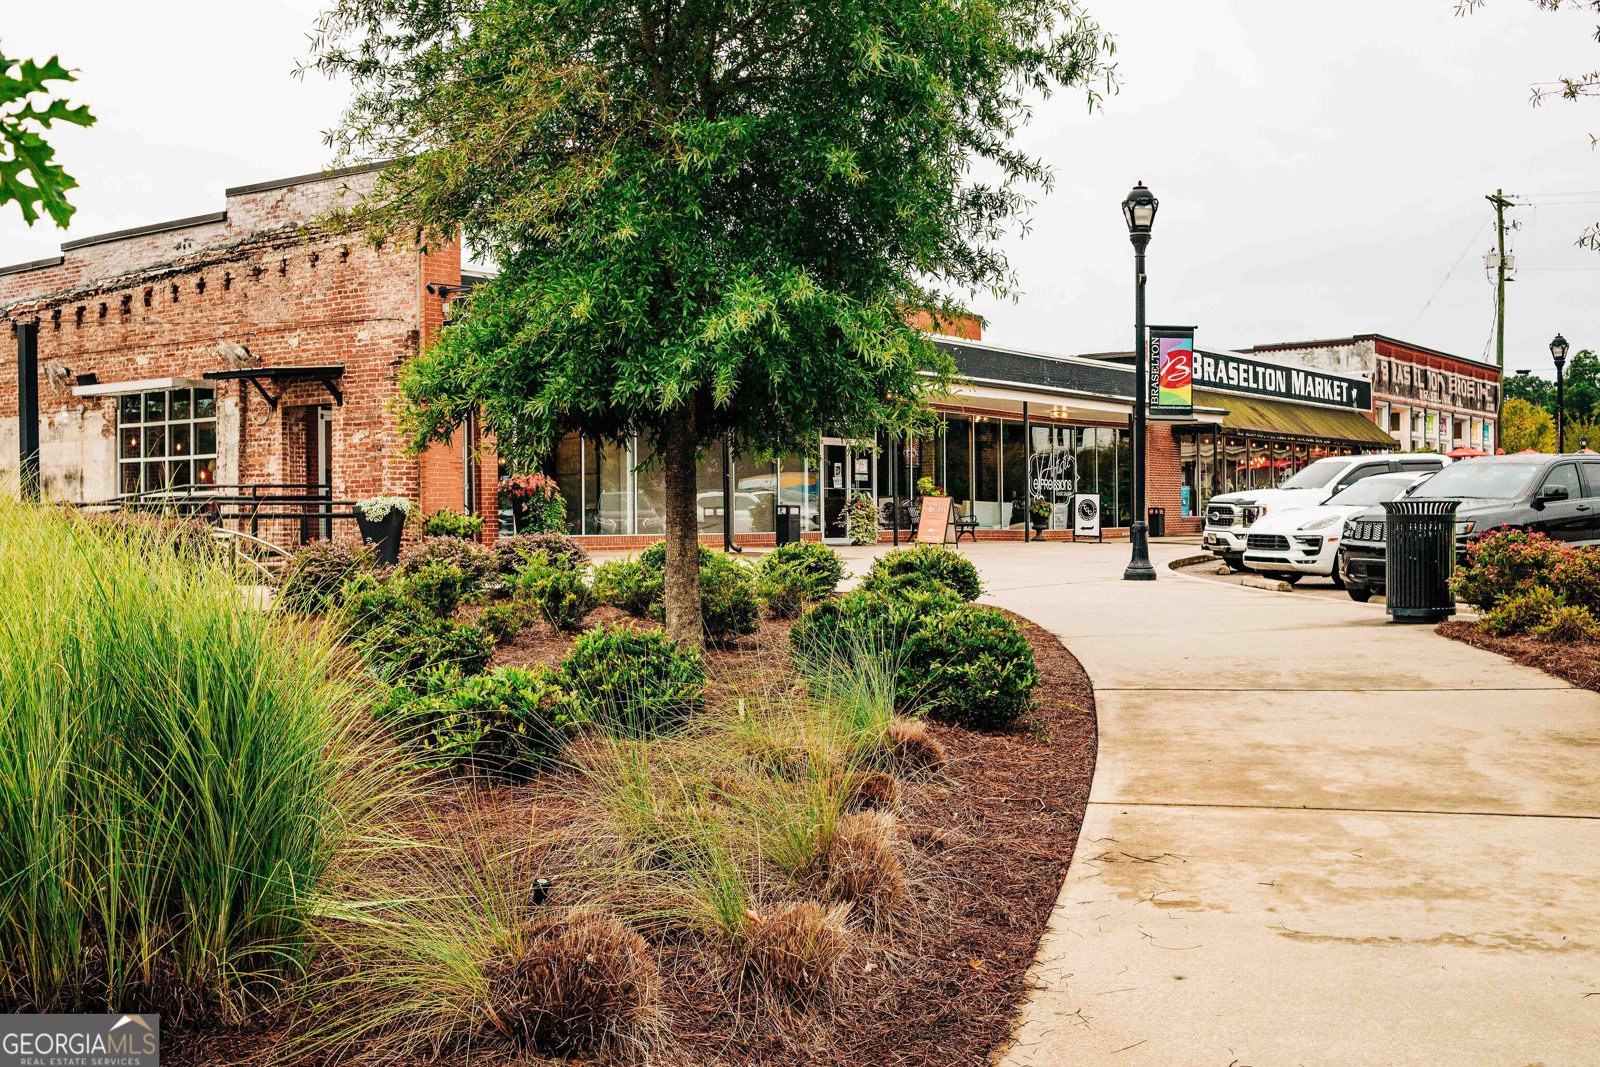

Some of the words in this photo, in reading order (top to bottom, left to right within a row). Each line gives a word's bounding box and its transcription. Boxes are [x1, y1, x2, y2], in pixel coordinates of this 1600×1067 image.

[1151, 337, 1160, 405] BRASELTON
[1192, 351, 1286, 393] BRASELTON
[1291, 370, 1349, 402] MARKET
